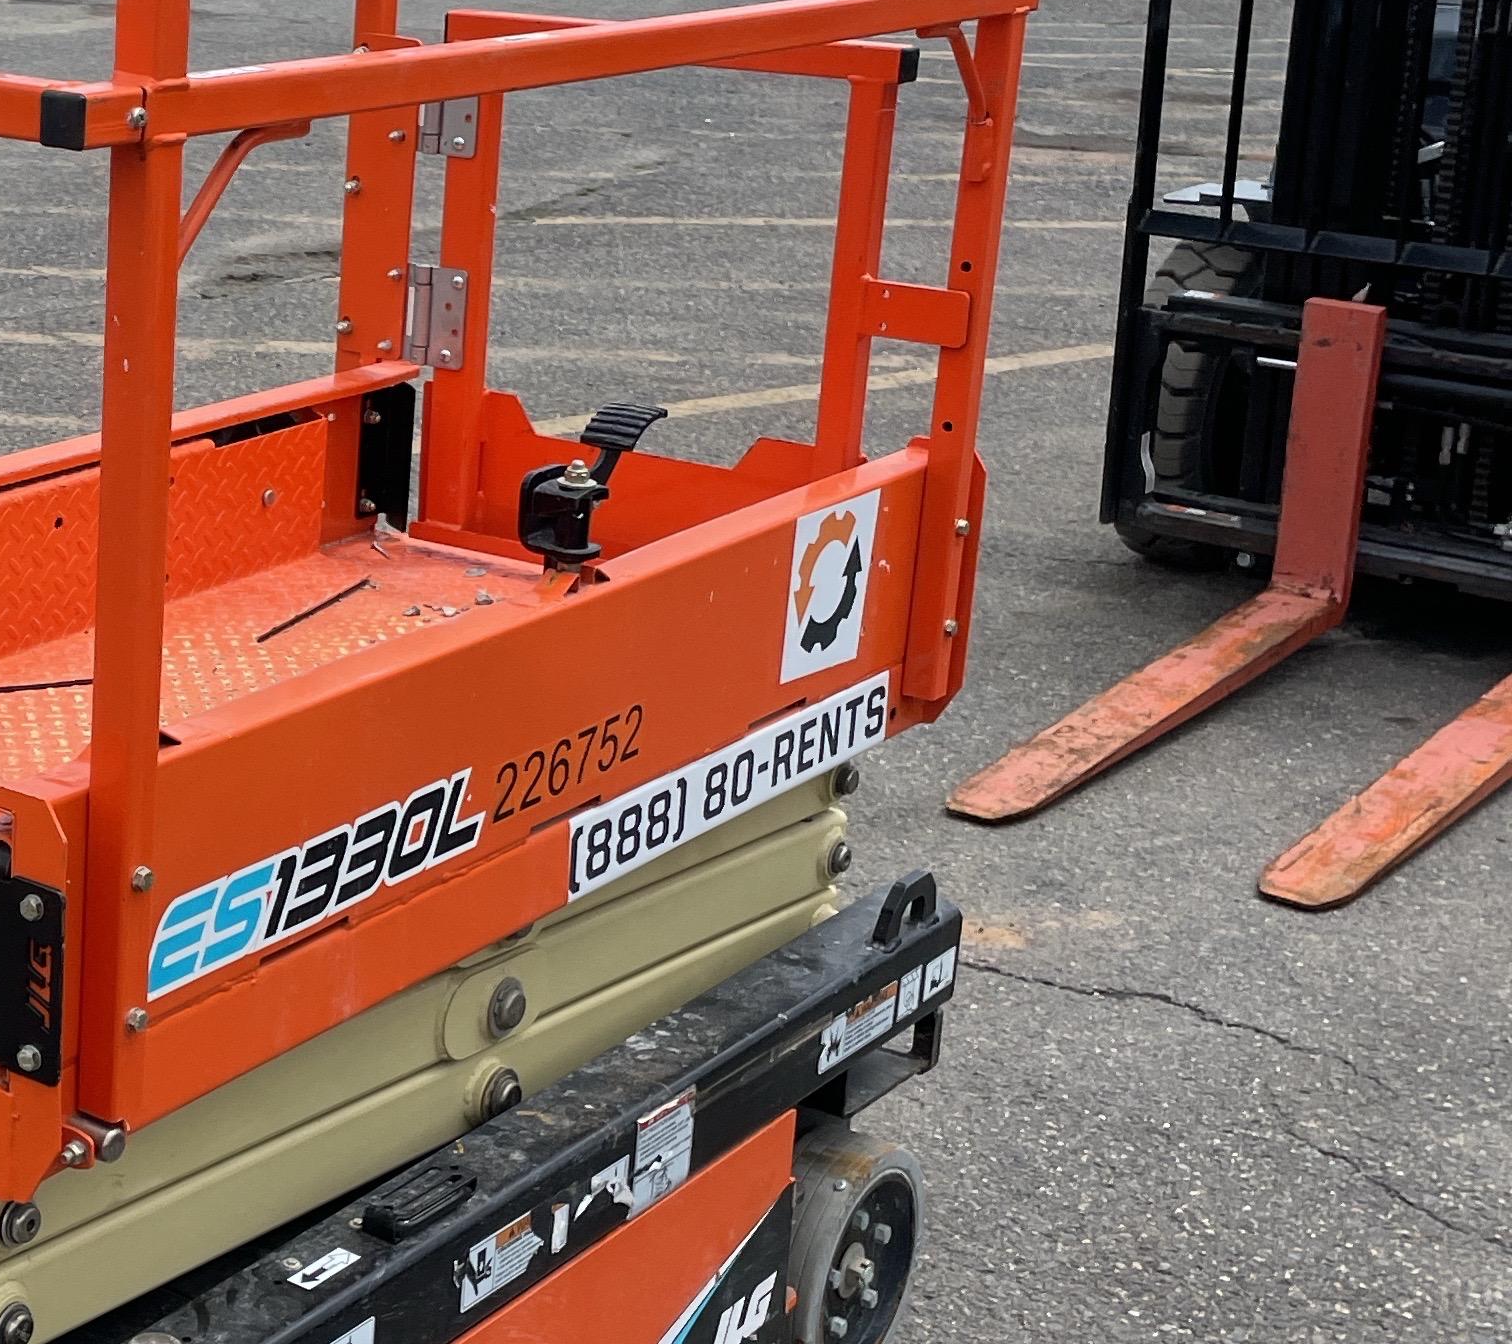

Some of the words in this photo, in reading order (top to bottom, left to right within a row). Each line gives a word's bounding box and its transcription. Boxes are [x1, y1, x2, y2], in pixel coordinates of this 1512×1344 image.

[492, 704, 643, 825] 226752
[568, 776, 688, 895] (888)
[702, 685, 886, 821] 80-RENTS
[148, 775, 481, 994] ES1330L
[28, 937, 53, 1034] JLG
